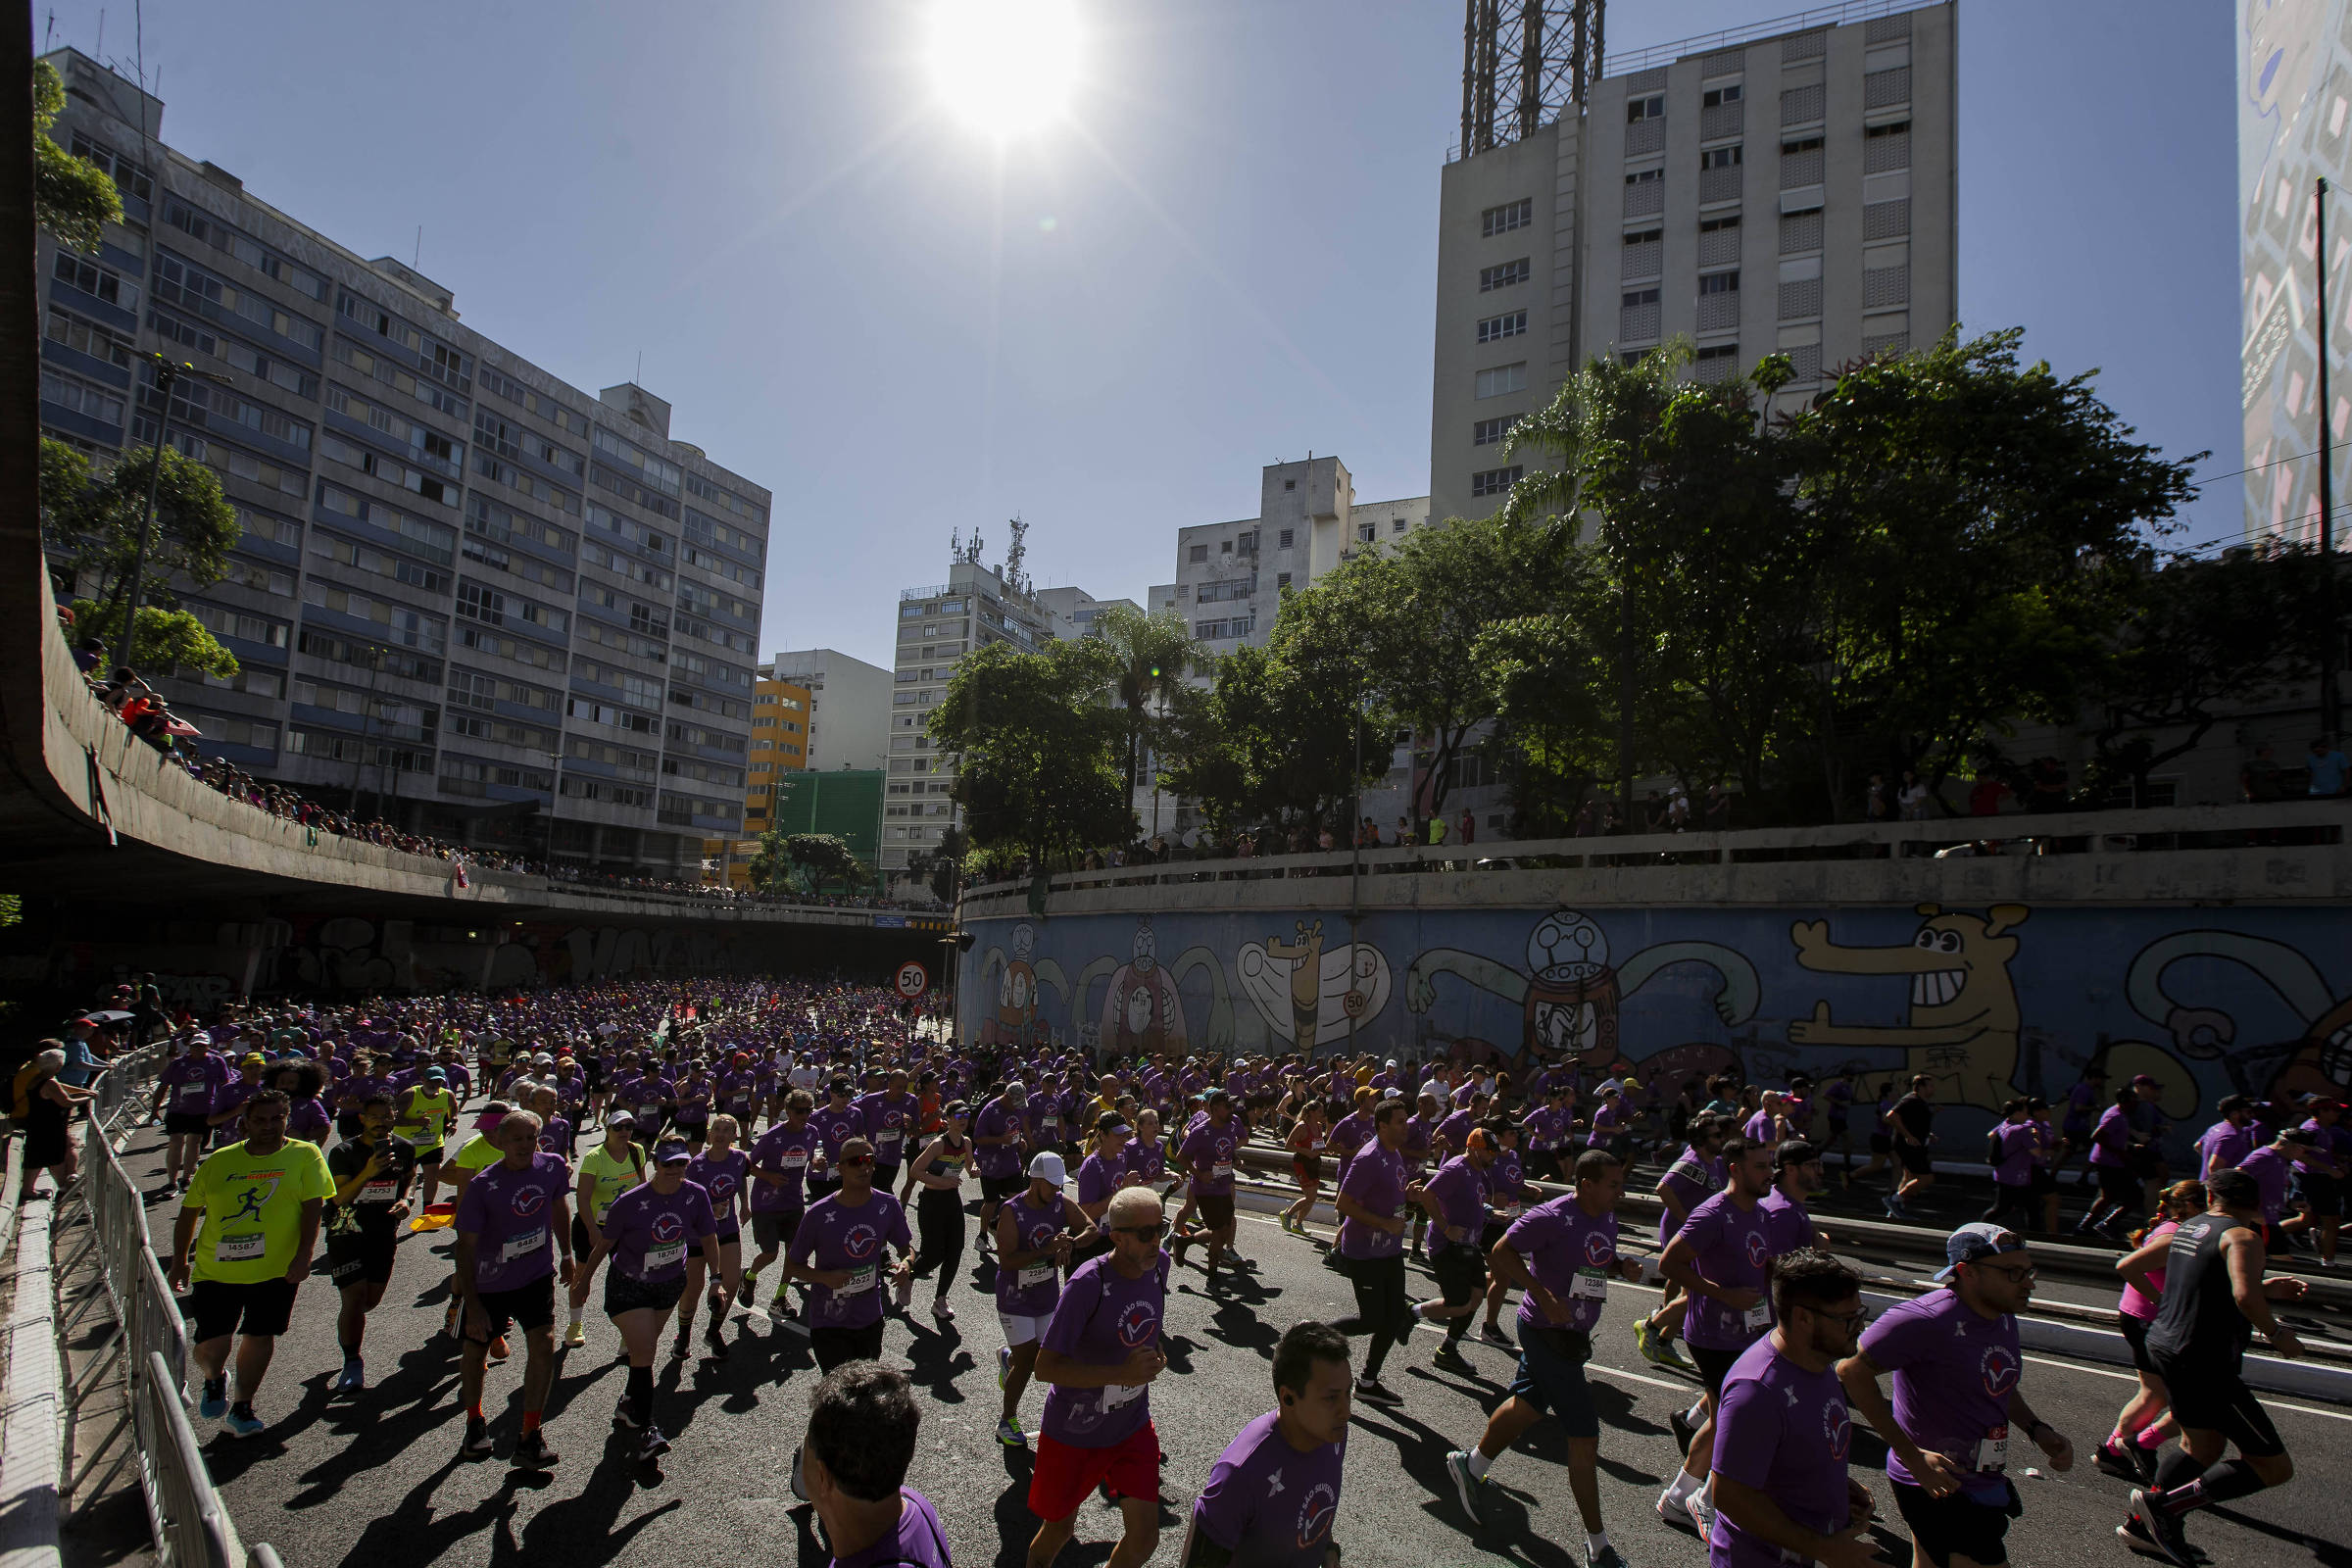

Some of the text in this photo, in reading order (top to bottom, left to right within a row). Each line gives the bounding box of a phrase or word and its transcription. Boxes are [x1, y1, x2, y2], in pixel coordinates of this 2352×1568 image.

[902, 971, 923, 988] 50
[1348, 995, 1363, 1008] 50
[228, 1242, 256, 1250] 14587
[658, 1249, 679, 1259] 18741
